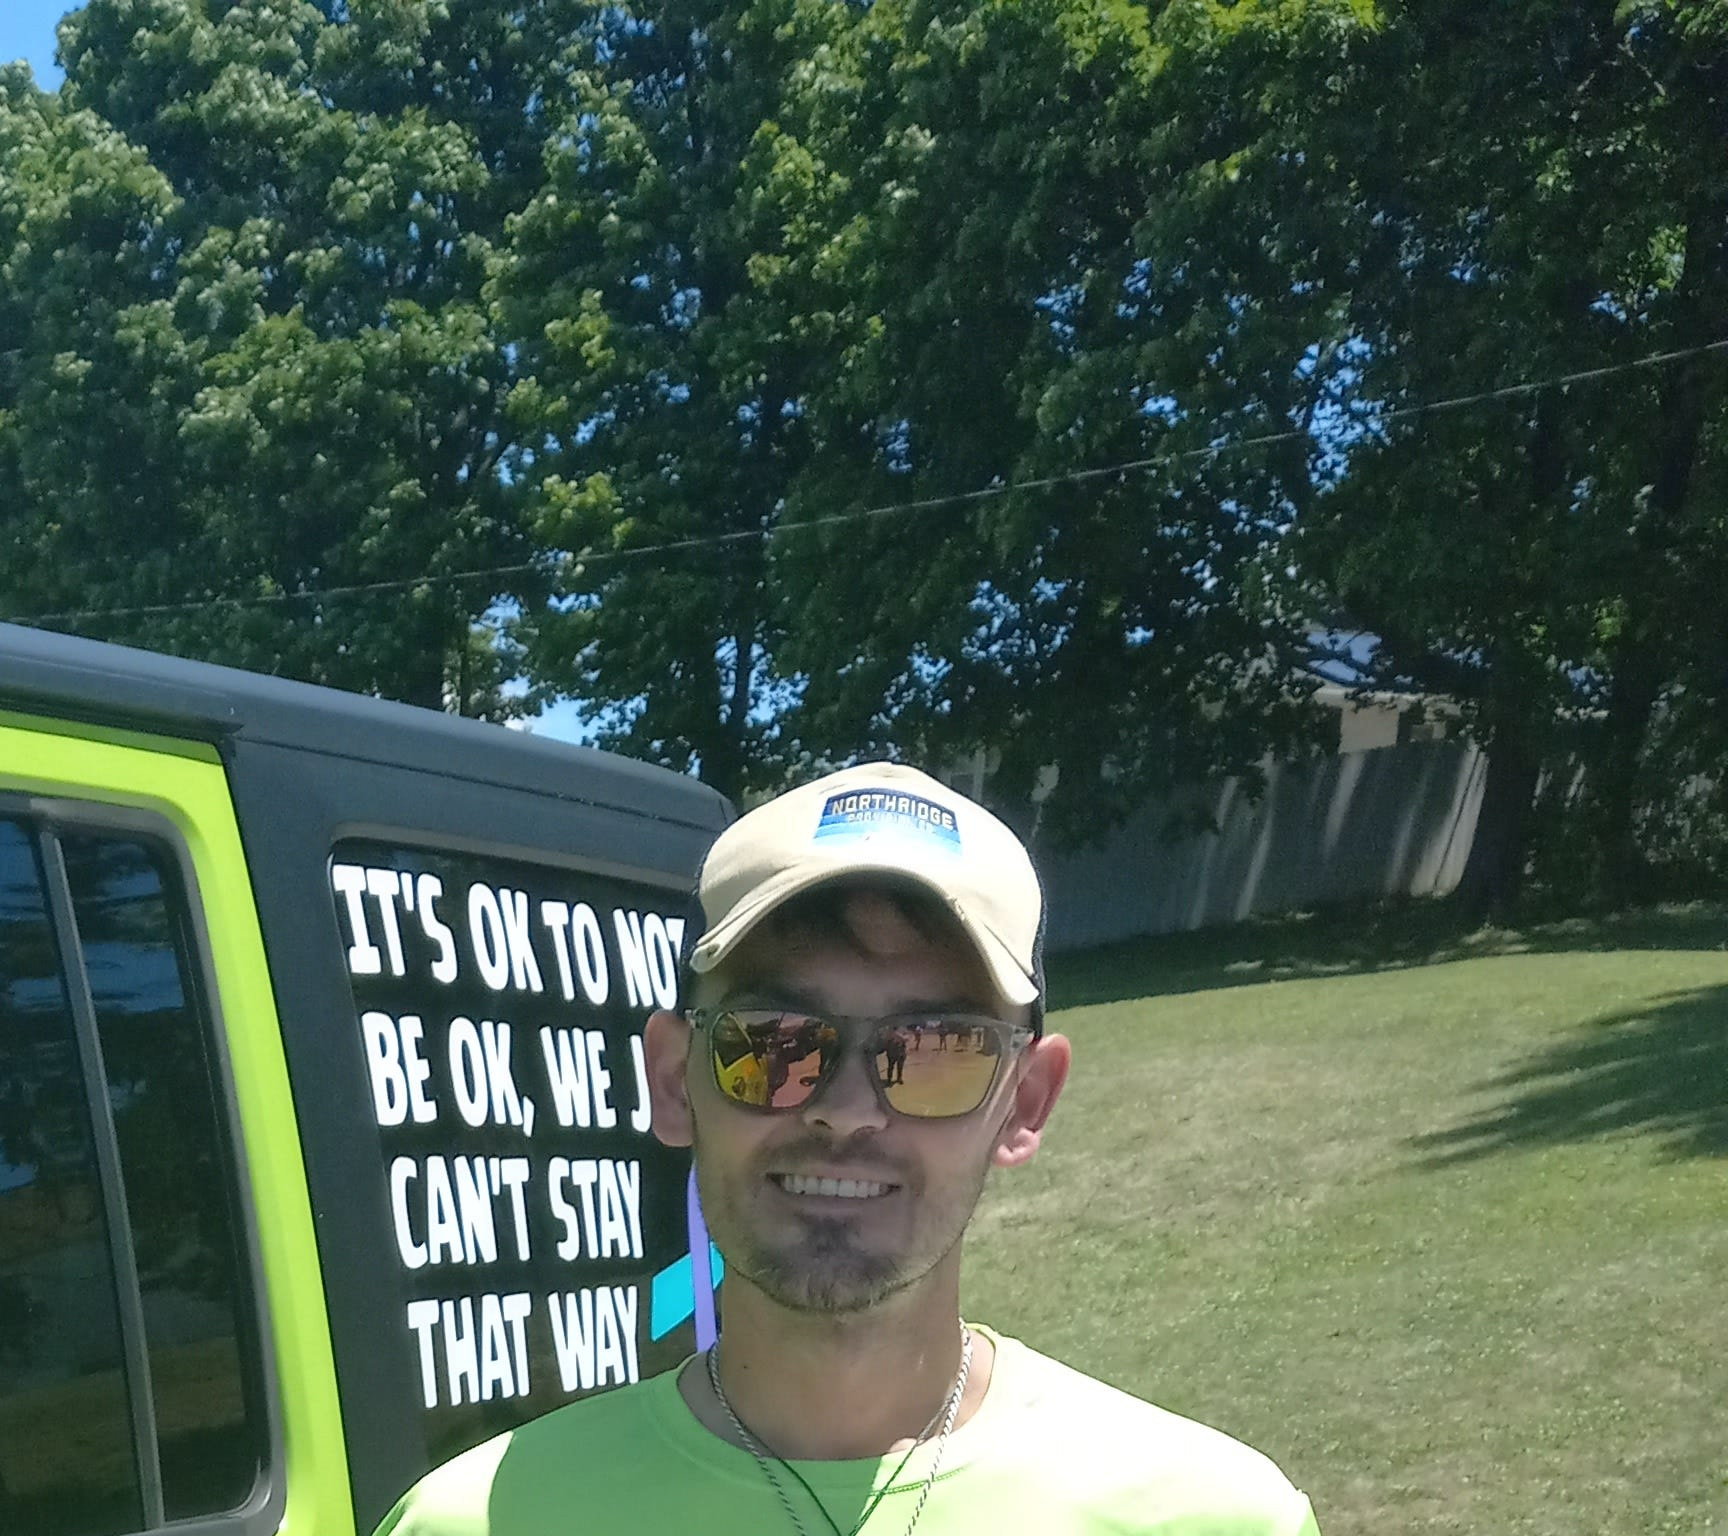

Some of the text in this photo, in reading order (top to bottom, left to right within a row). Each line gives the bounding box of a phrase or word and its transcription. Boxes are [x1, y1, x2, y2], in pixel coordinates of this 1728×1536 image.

[832, 794, 954, 831] NORTHRIDGE
[333, 866, 457, 983] IT'S
[469, 885, 542, 991] OK
[543, 903, 608, 1003] TO
[363, 1012, 436, 1124] BE
[450, 1018, 533, 1136] OK,
[541, 1028, 616, 1127] WE
[391, 1157, 643, 1268] CAN'T STAY
[408, 1287, 638, 1407] THAT WAY
